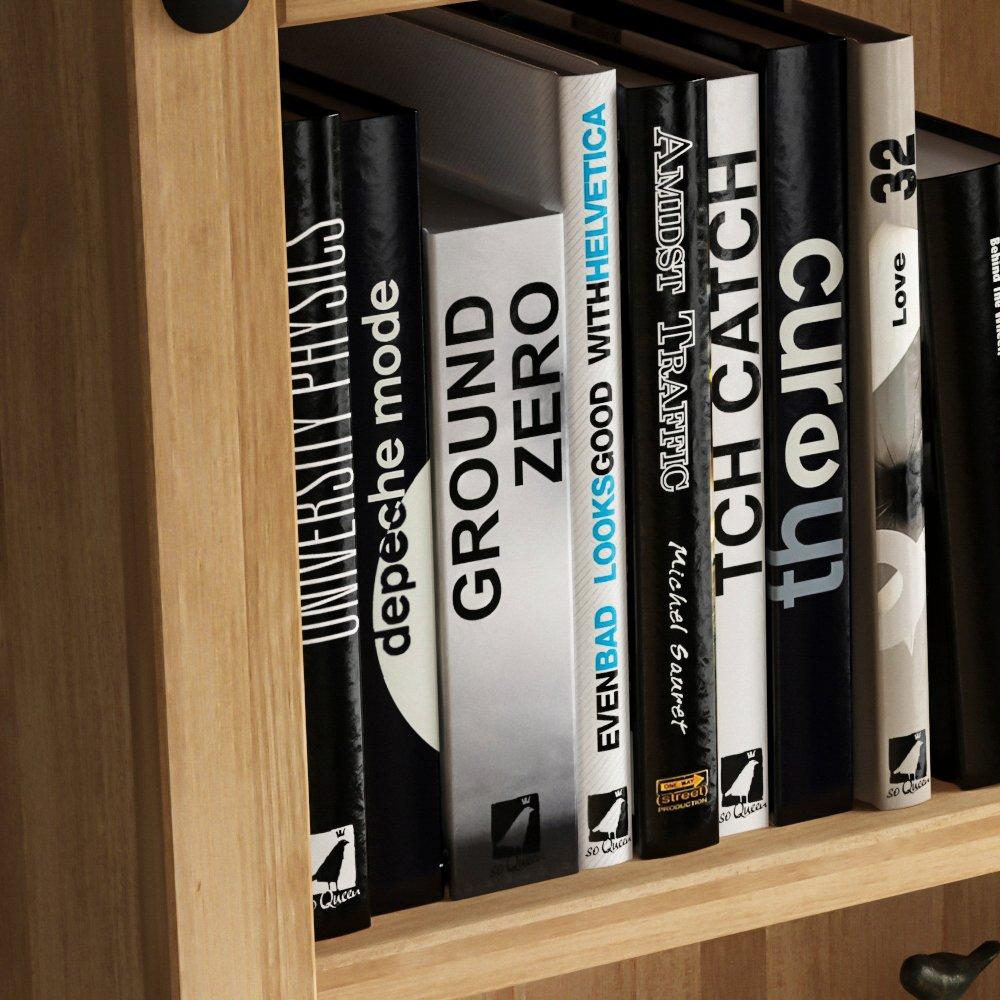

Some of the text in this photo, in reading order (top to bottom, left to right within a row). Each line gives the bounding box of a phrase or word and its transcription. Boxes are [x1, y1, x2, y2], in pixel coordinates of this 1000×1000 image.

[869, 133, 917, 204] 32
[286, 218, 350, 395] PHYSICS
[510, 281, 563, 485] ZERO
[654, 126, 695, 492] AMIDST TRAFFIC
[707, 150, 763, 597] TCH CATCH
[892, 252, 908, 328] Love
[361, 279, 416, 656] depeche mode
[445, 296, 502, 621] GROUND
[668, 541, 689, 735] Michel Sauret
[320, 888, 361, 910] Queen
[733, 801, 768, 819] Queen
